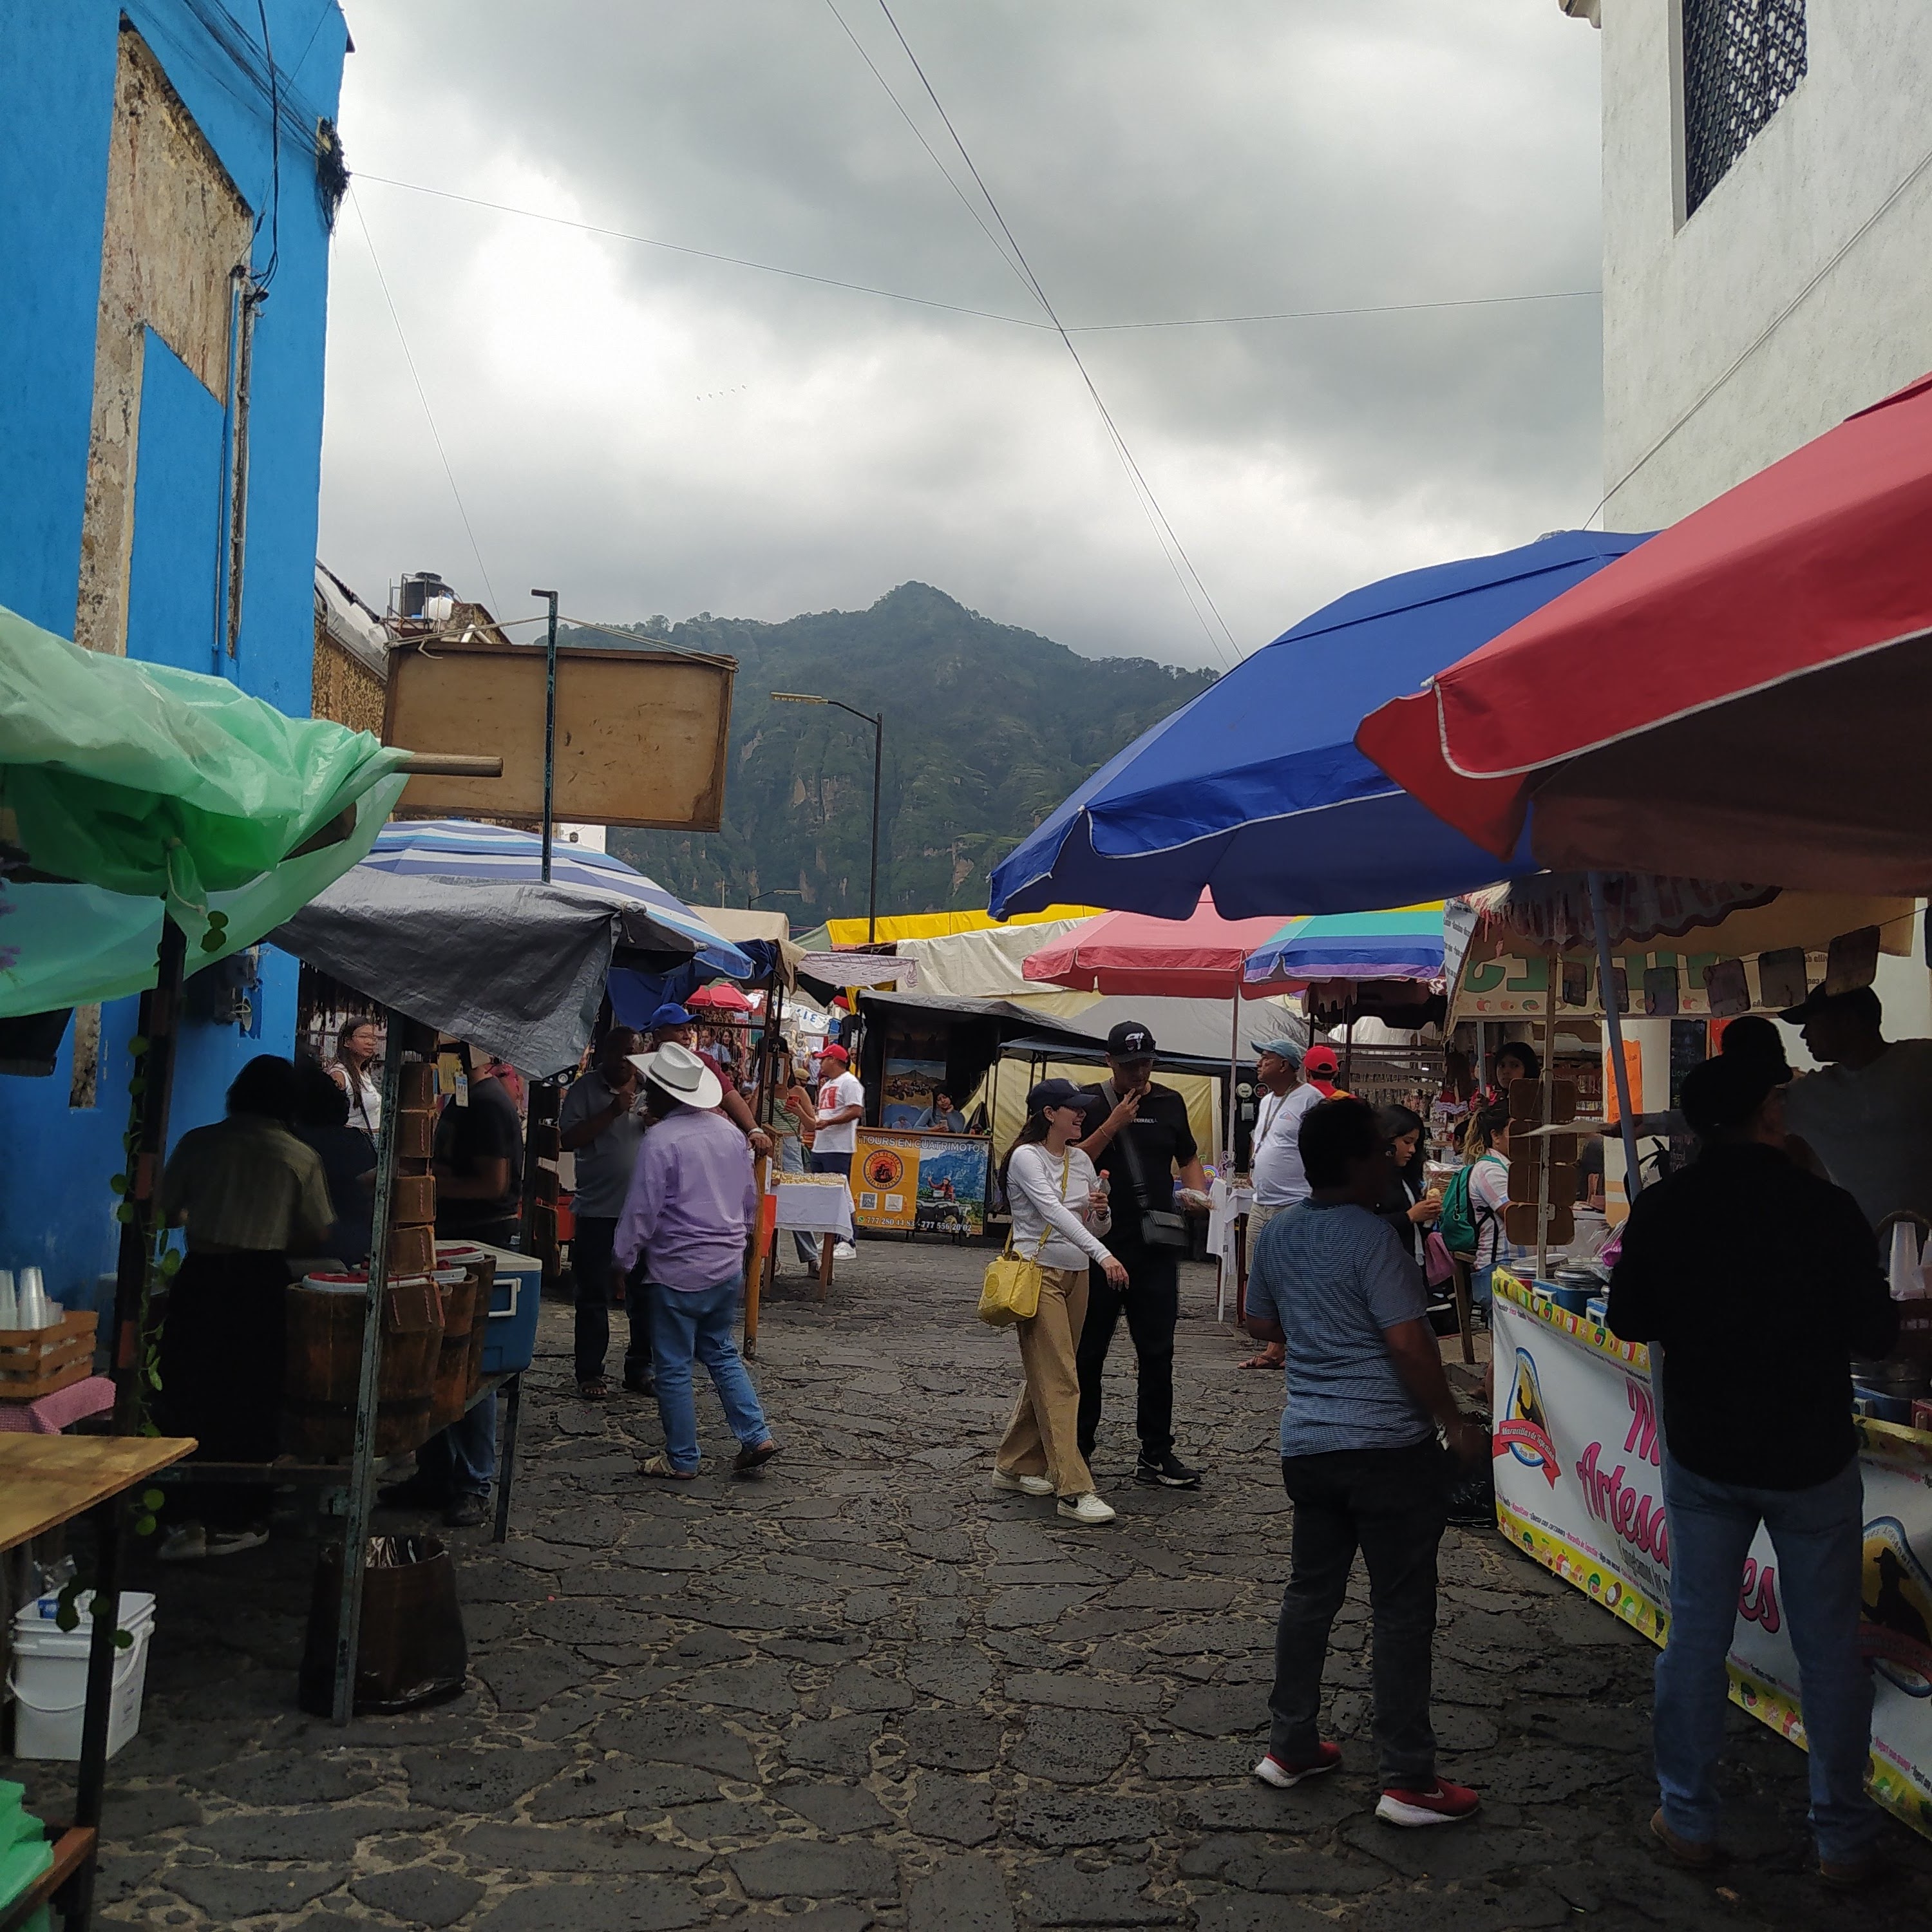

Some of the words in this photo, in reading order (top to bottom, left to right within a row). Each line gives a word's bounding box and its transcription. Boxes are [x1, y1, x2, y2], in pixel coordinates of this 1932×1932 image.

[897, 1138, 912, 1148] EN
[914, 1139, 983, 1153] CUATRIMOTO!
[866, 1216, 880, 1224] 777
[881, 1217, 895, 1226] 280
[1501, 1426, 1530, 1437] Maravillas
[1530, 1430, 1537, 1440] de
